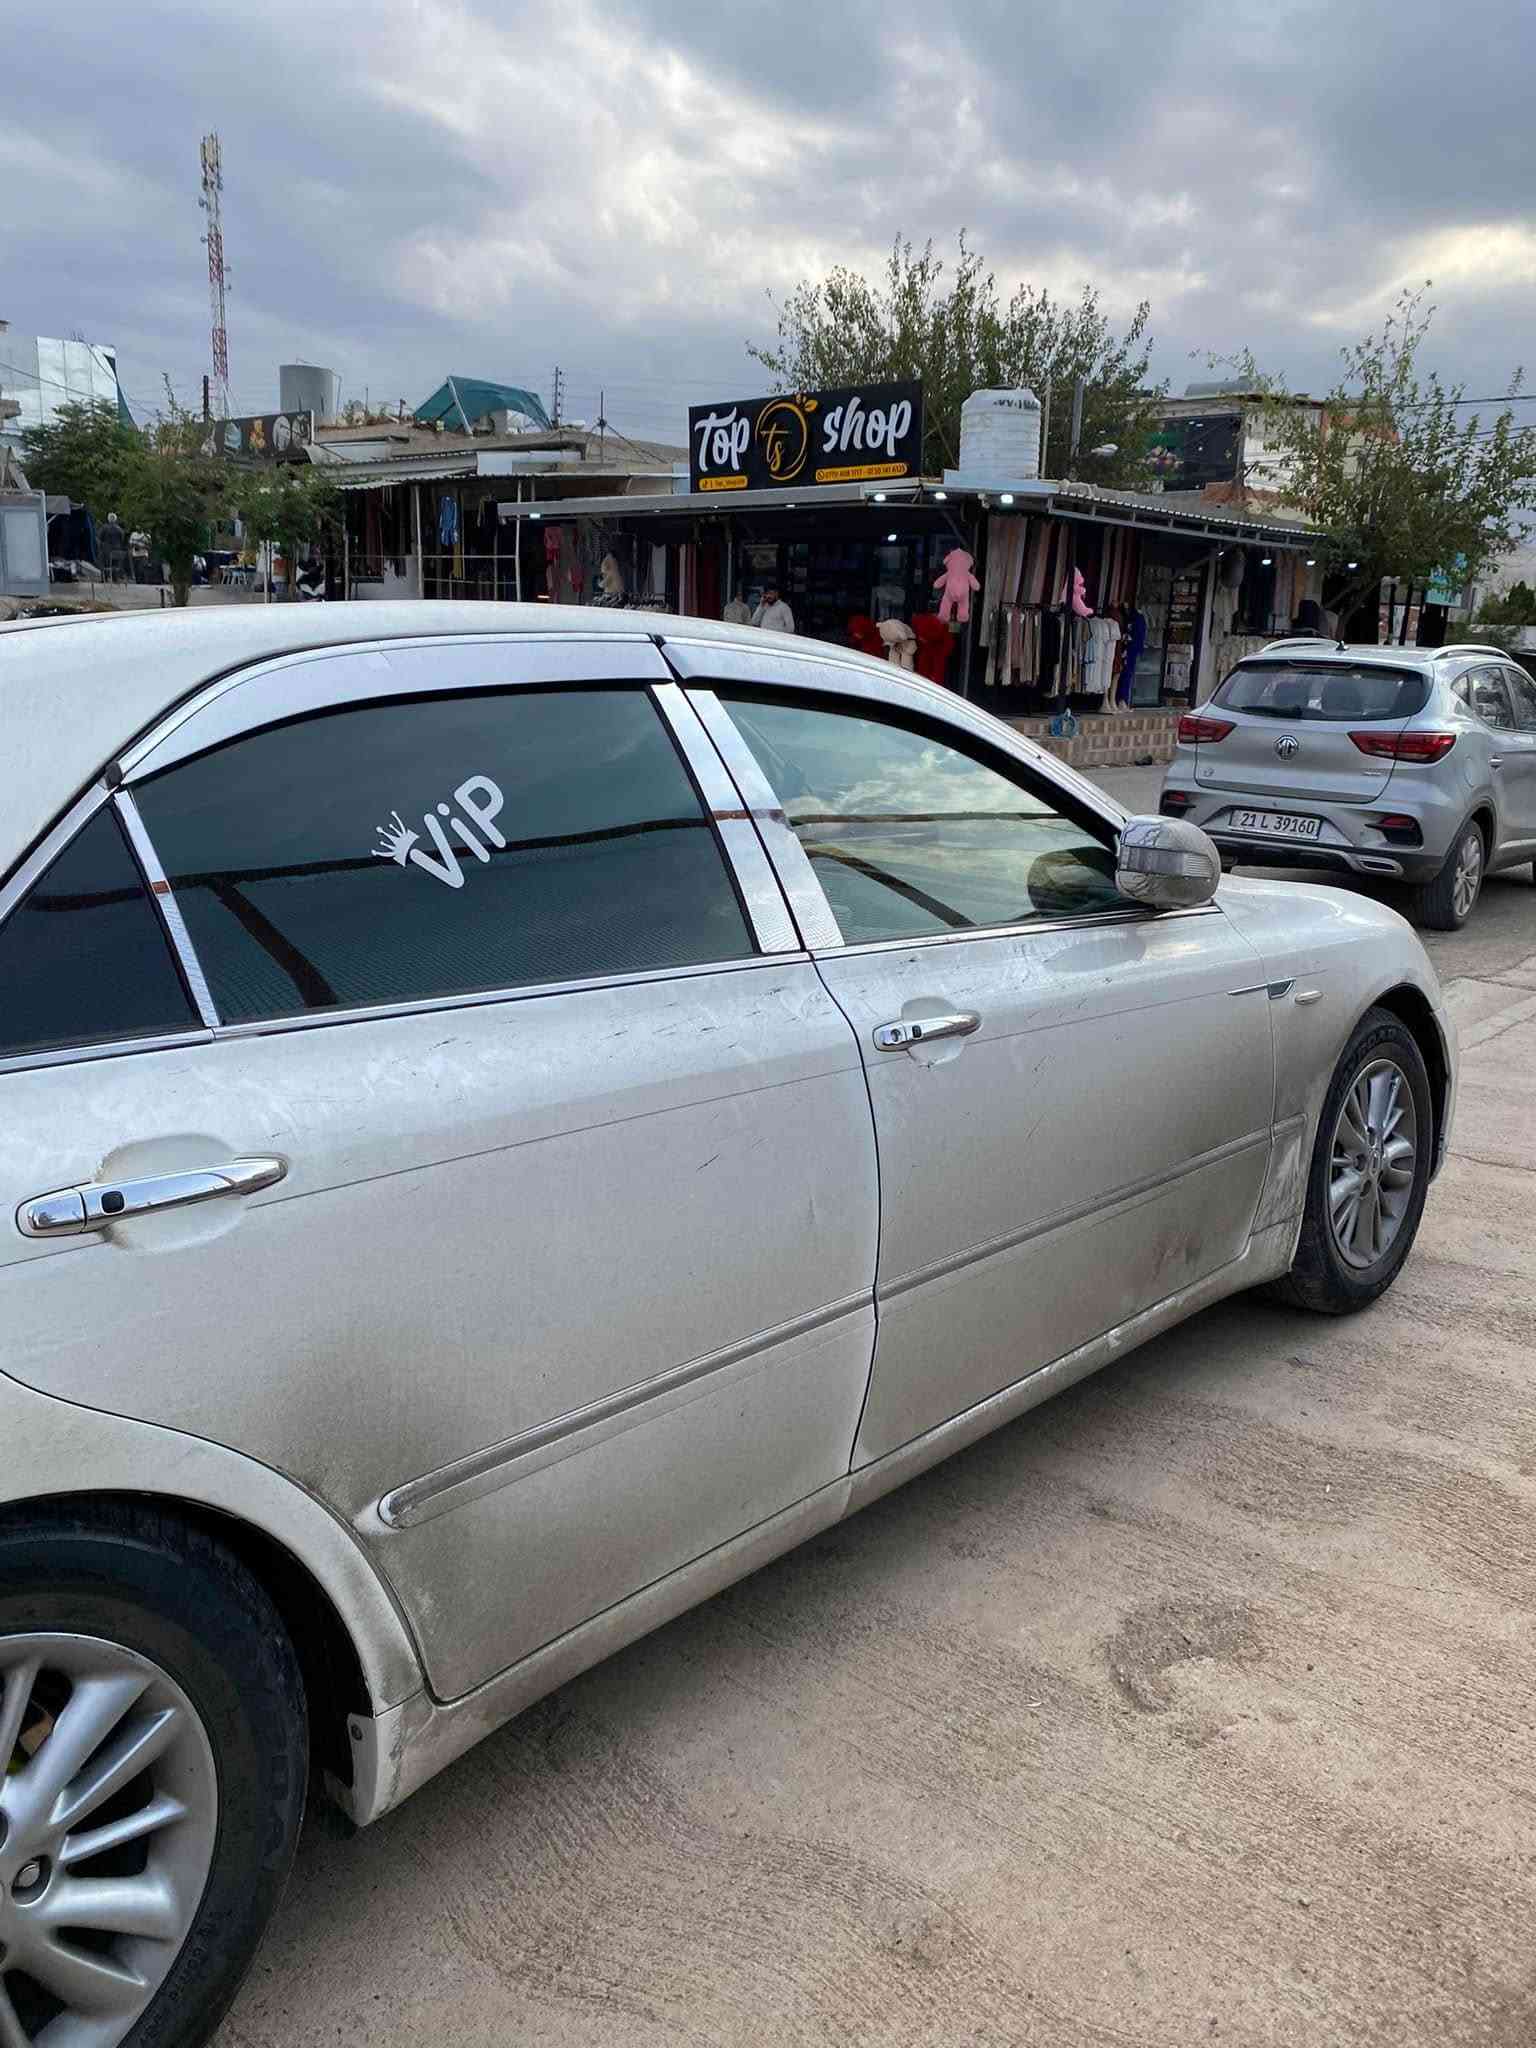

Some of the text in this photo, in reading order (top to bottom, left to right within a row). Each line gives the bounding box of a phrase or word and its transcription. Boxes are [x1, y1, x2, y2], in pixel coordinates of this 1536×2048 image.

[695, 396, 912, 471] Top shop
[1240, 812, 1316, 835] 21 L 39160
